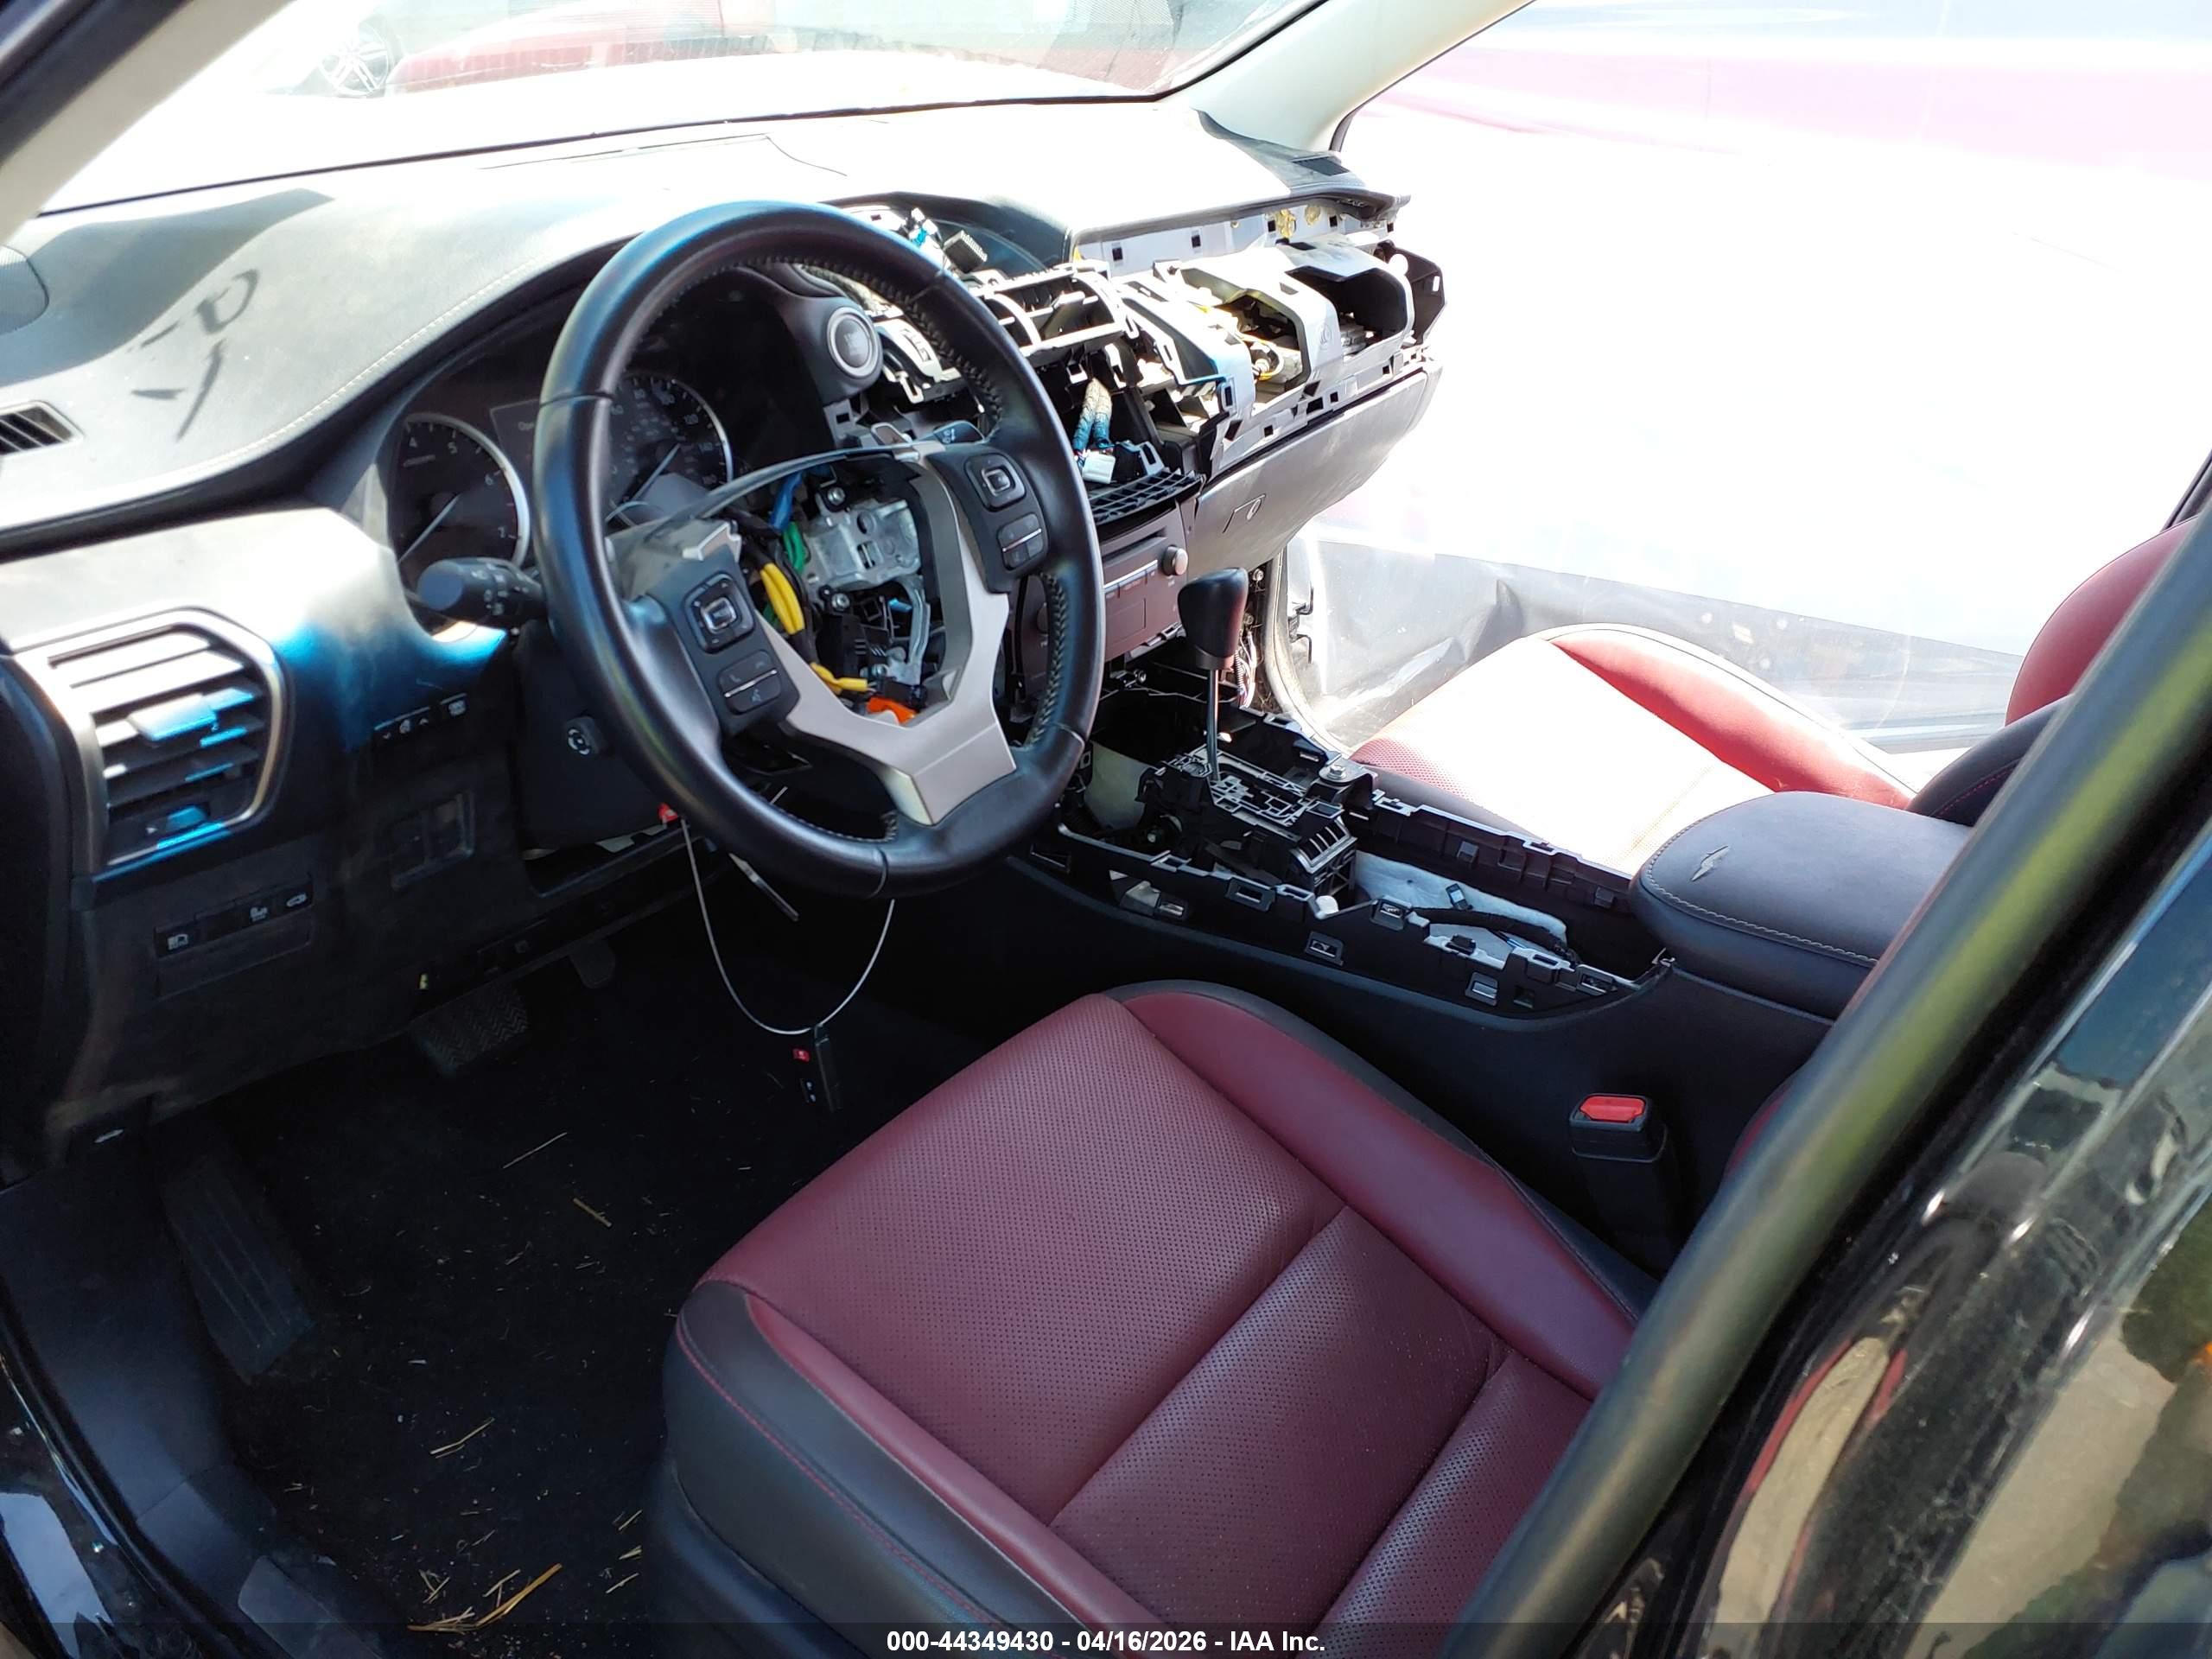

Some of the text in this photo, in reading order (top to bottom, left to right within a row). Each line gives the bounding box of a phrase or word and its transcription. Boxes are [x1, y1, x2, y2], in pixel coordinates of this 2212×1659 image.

[408, 436, 418, 448] 4
[447, 441, 458, 454] 5
[484, 474, 494, 486] 6
[497, 526, 506, 539] 7
